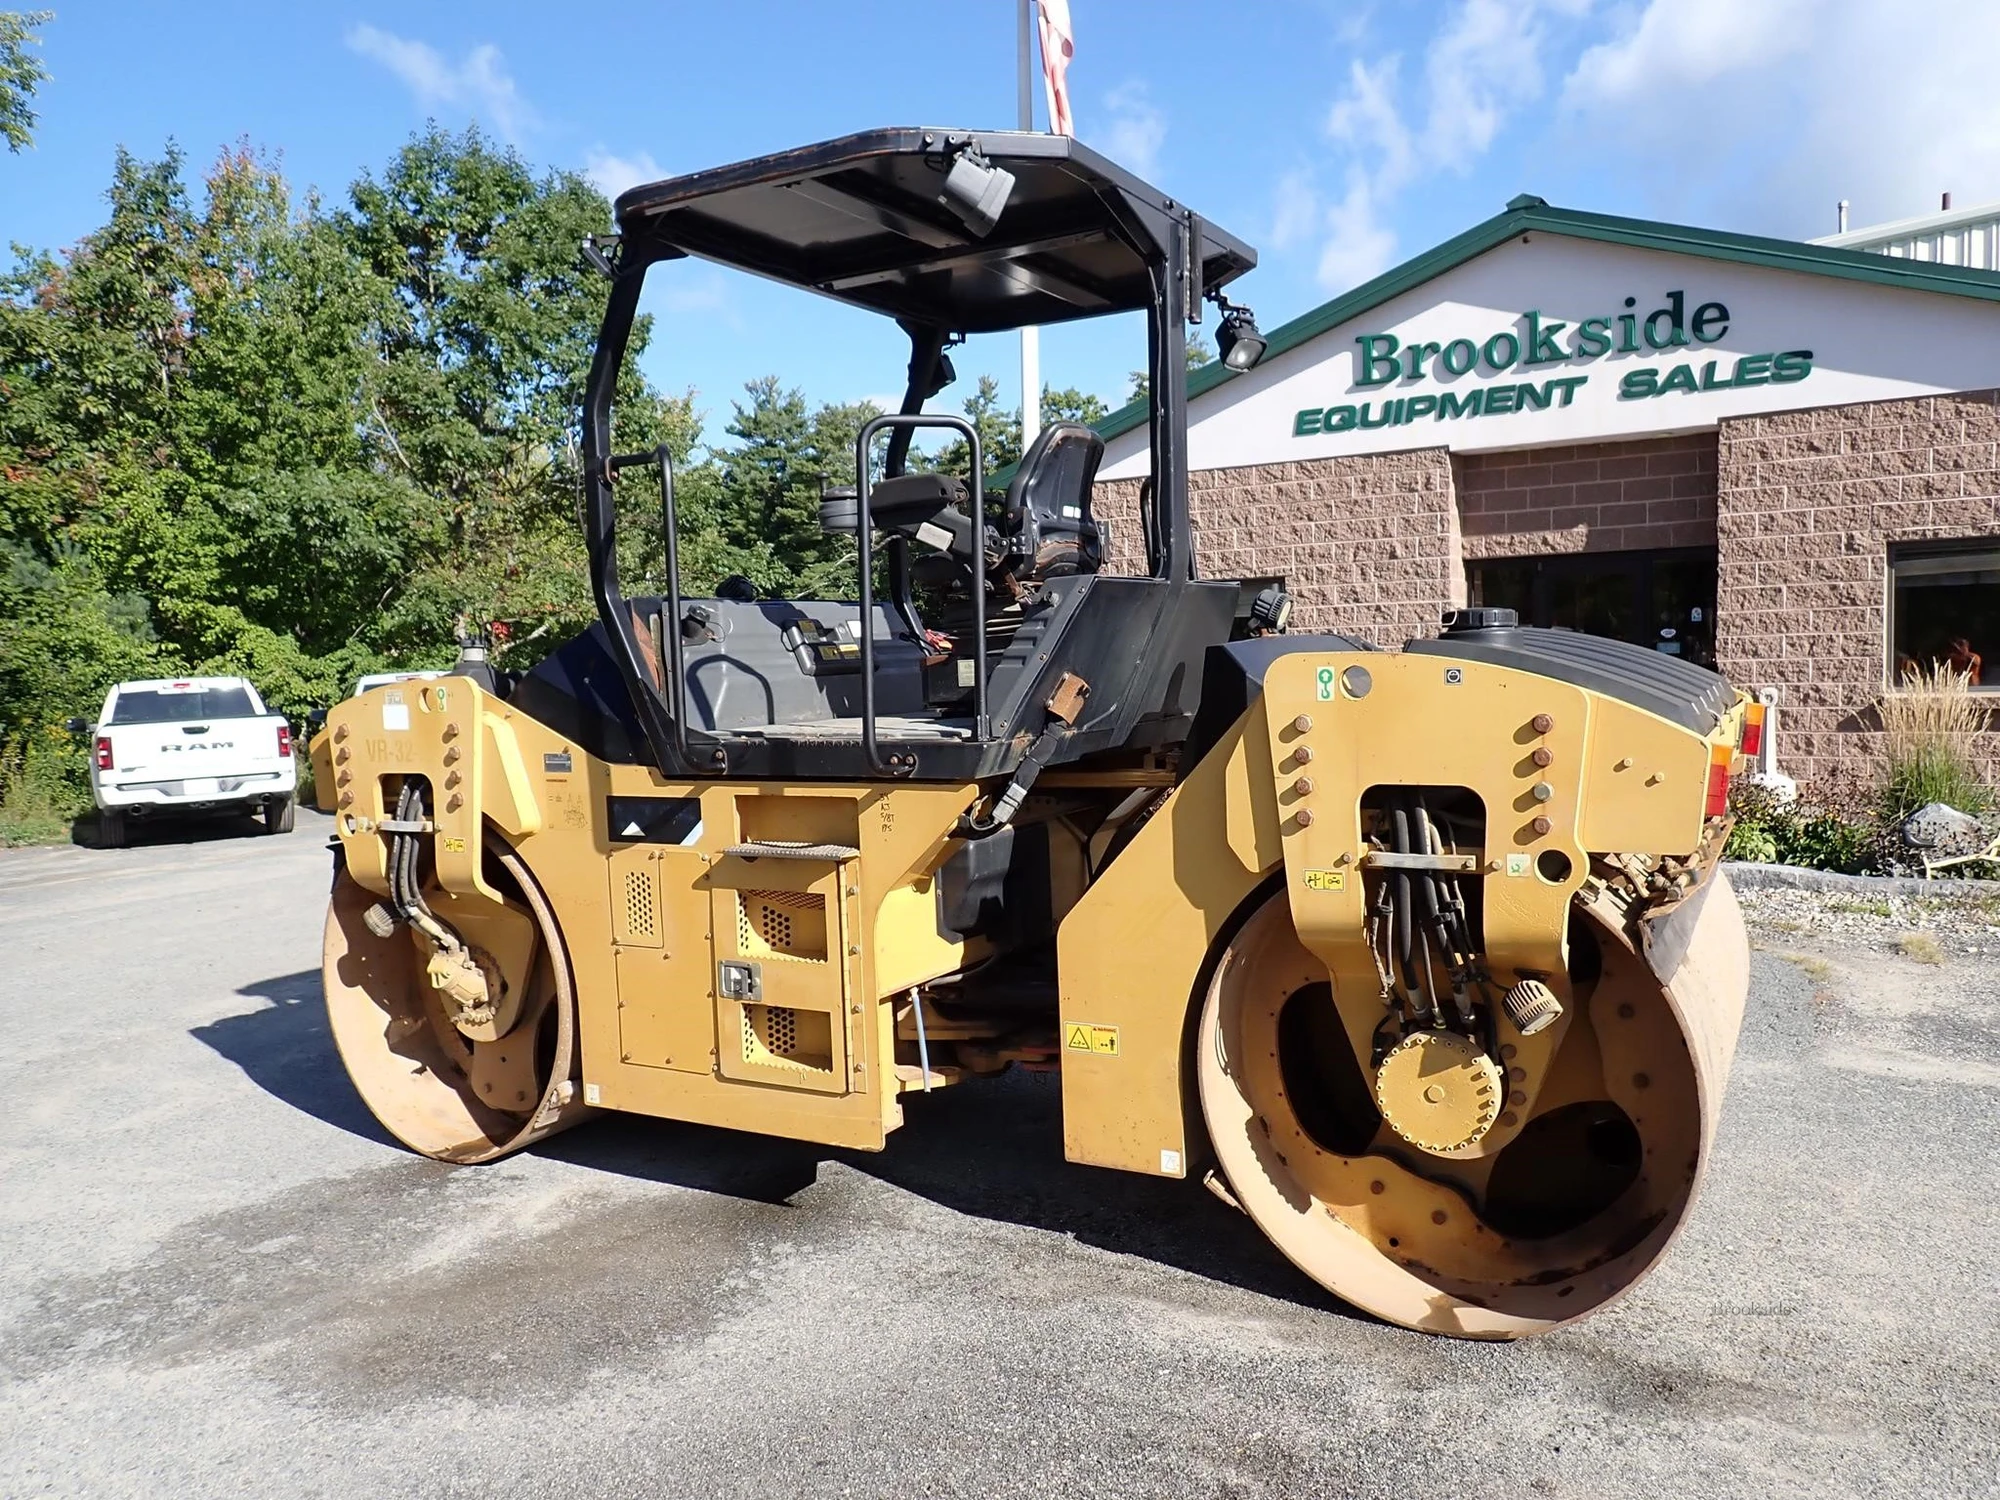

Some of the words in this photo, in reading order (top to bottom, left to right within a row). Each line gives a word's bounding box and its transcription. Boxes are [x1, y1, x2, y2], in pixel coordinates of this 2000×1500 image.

[1354, 290, 1731, 387] Brookside
[1294, 376, 1588, 437] EQUIPMENT
[1620, 350, 1813, 399] SALES
[161, 741, 234, 753] RAM
